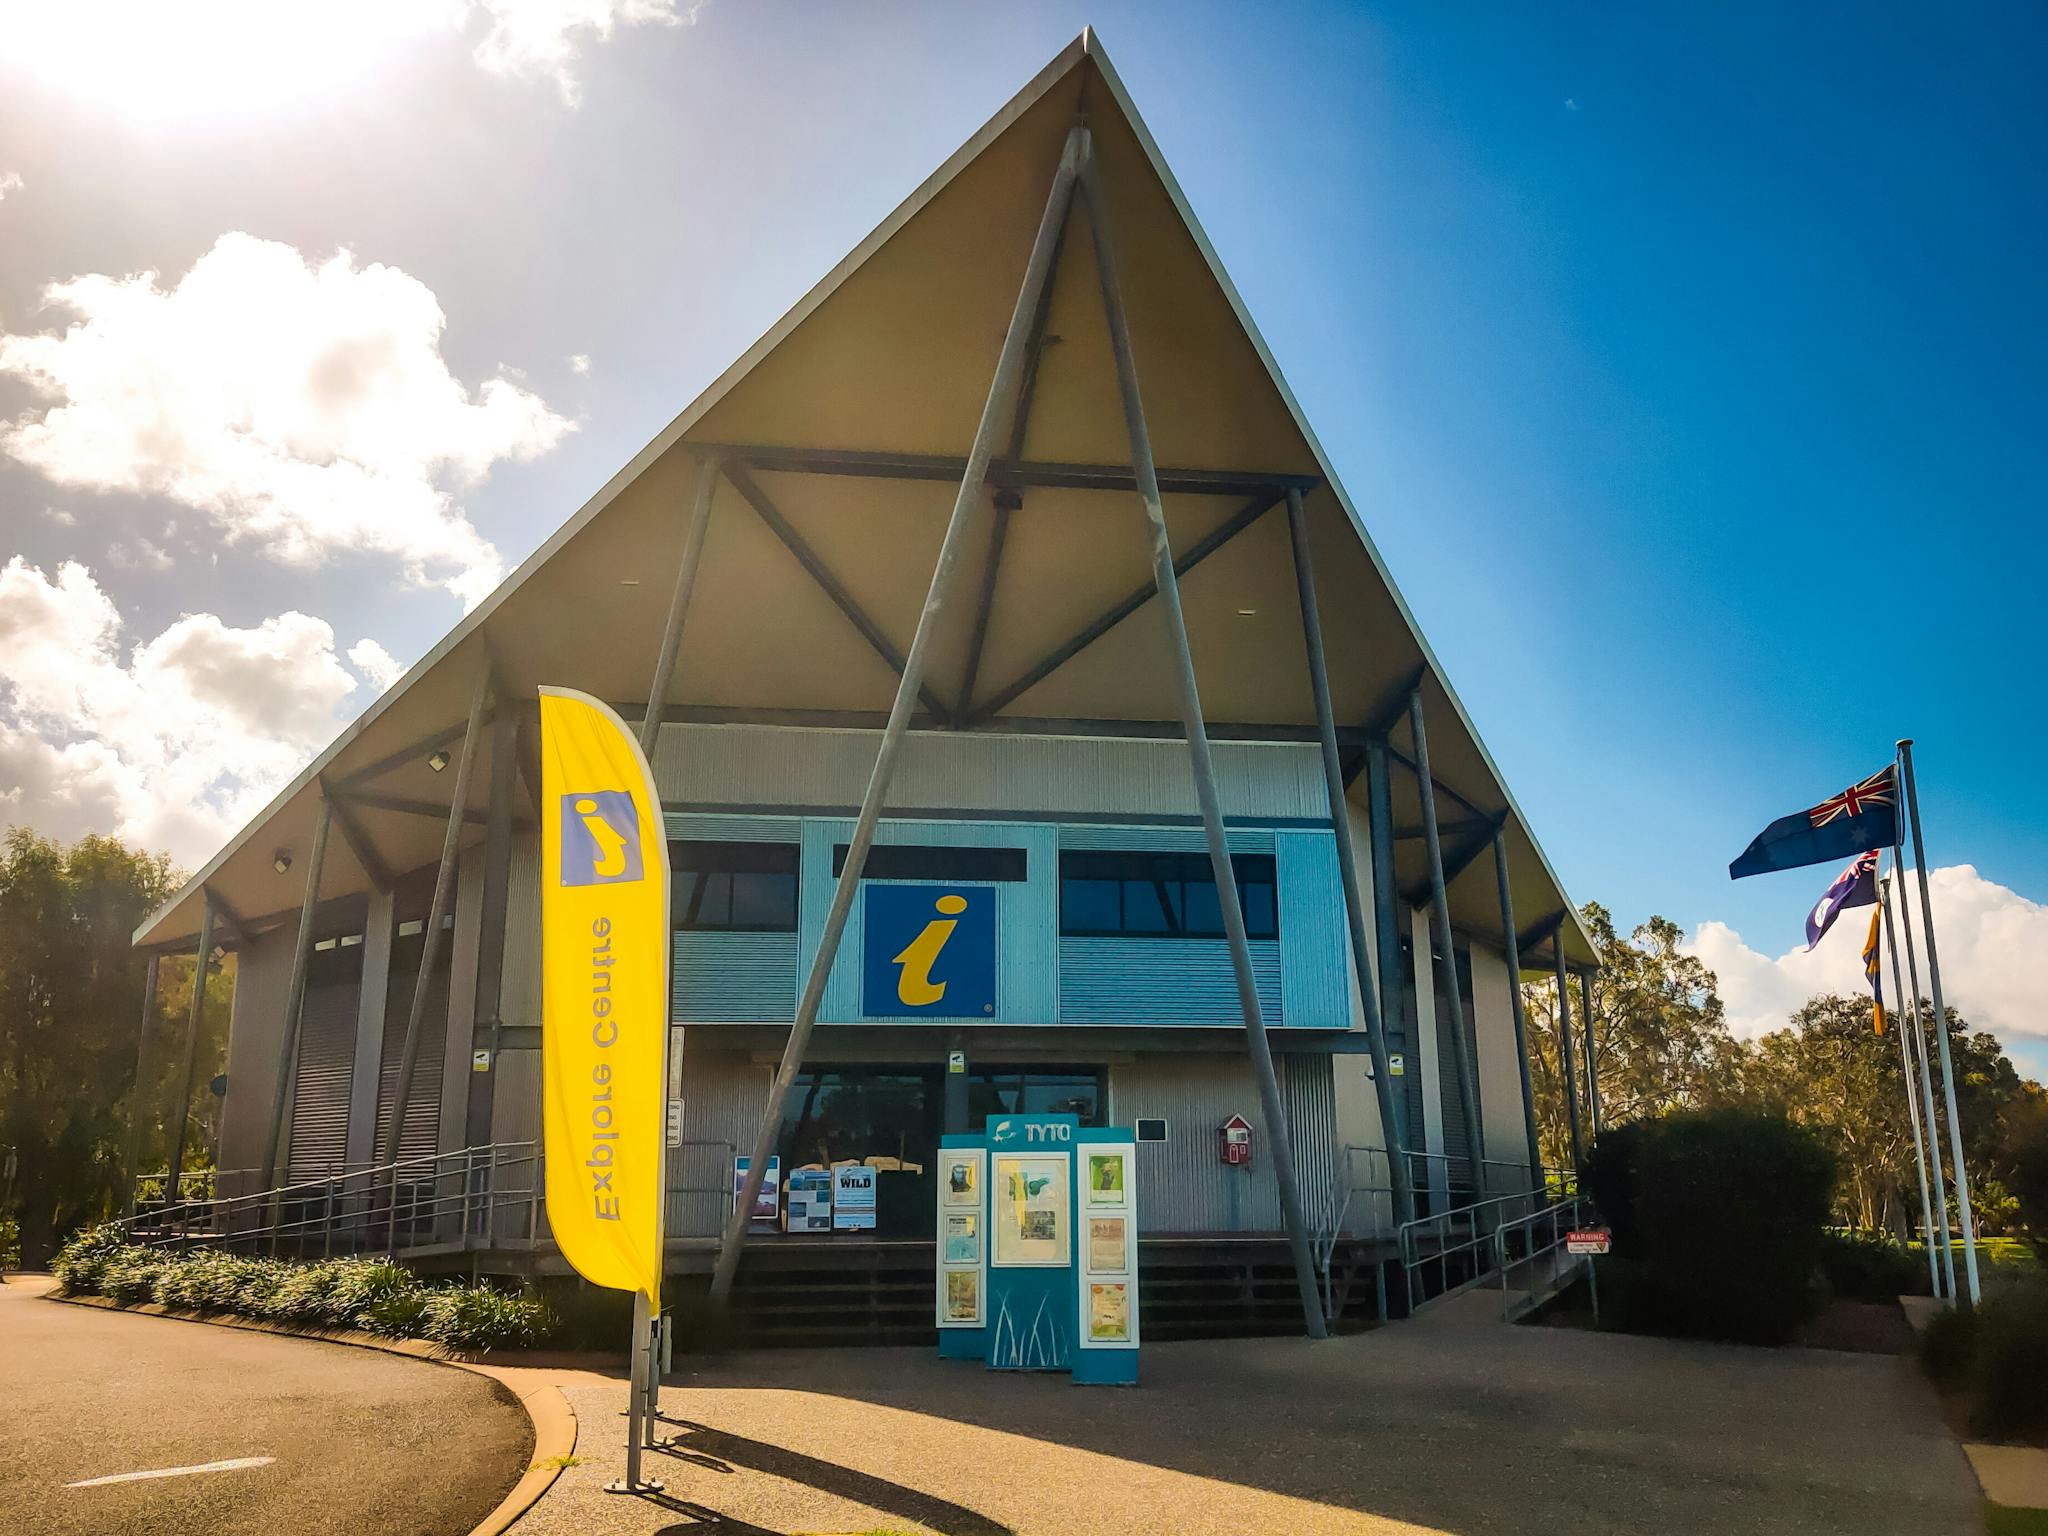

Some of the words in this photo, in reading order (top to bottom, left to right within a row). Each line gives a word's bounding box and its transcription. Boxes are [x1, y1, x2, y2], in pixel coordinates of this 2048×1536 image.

[1025, 1123, 1071, 1142] TYTO
[840, 1178, 871, 1188] WILD
[1569, 1233, 1605, 1241] WARNING
